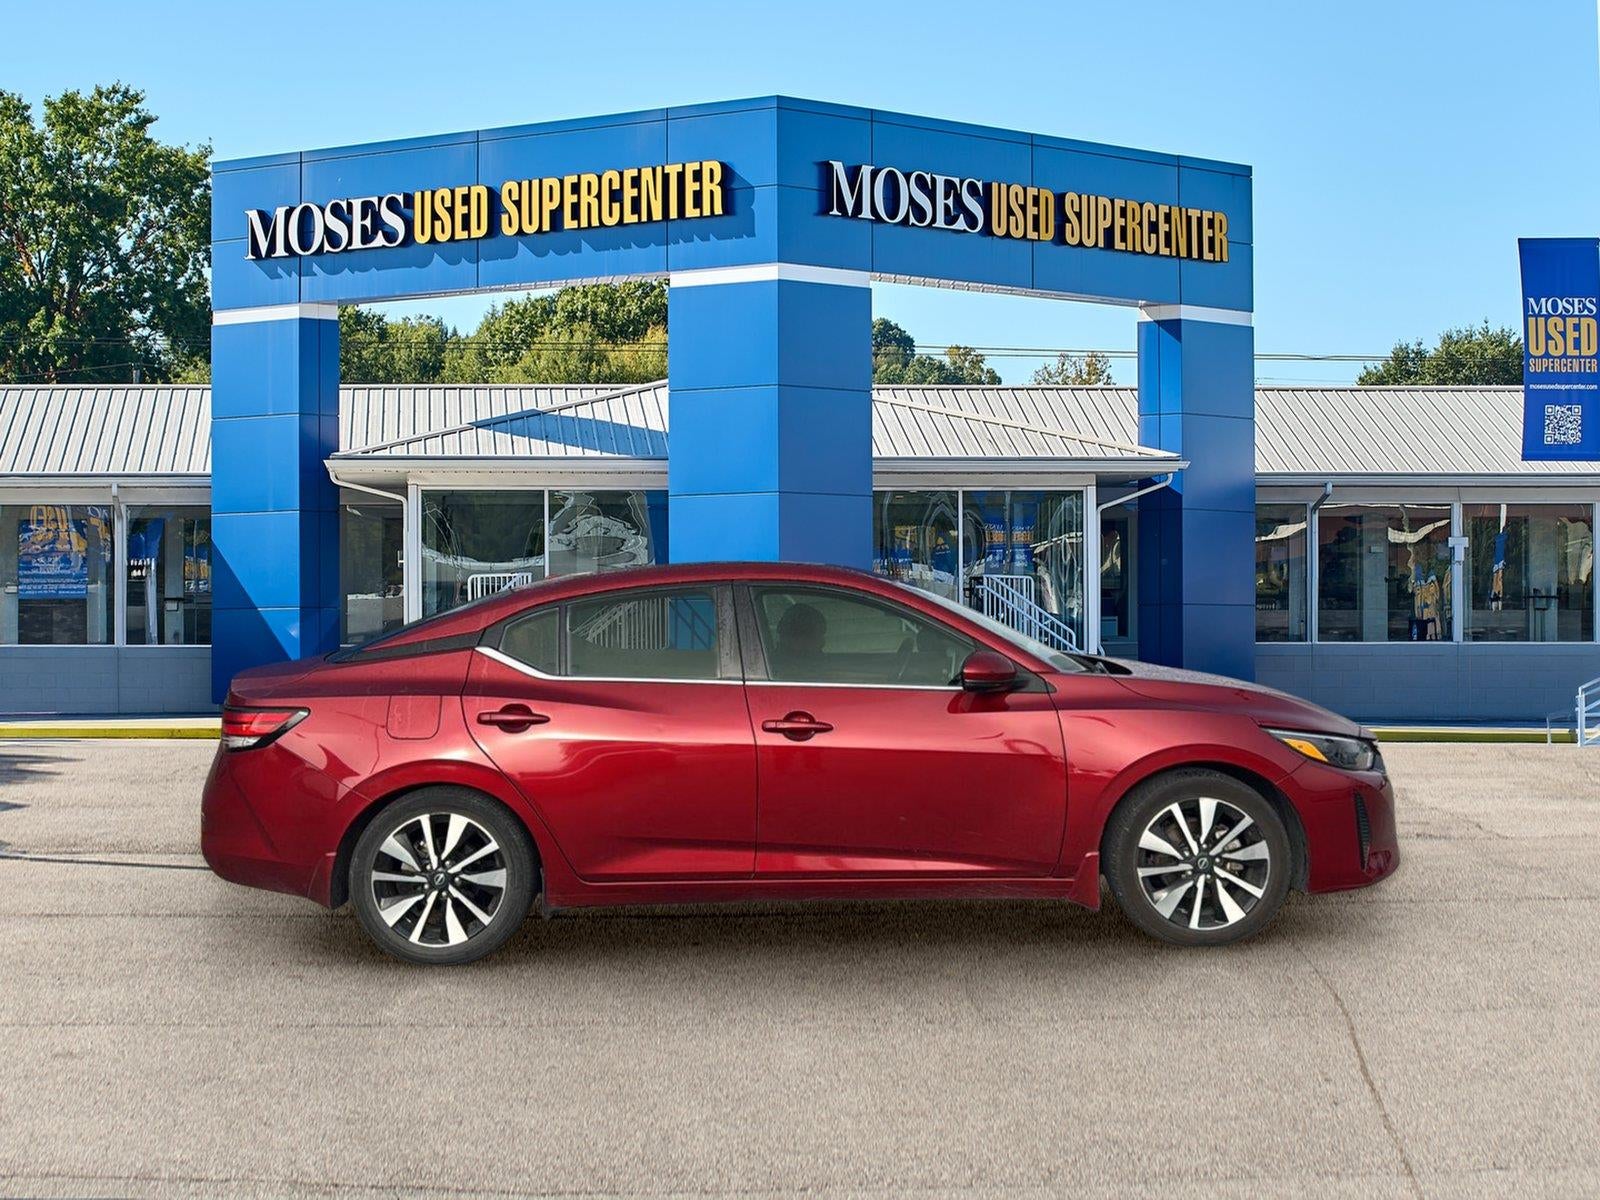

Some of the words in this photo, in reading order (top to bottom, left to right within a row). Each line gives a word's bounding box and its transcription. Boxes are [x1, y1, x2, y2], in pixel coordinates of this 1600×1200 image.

[245, 193, 407, 260] MOSES
[413, 185, 489, 244] USED
[501, 160, 725, 236] SUPERCENTER
[828, 160, 984, 233] MOSES
[991, 182, 1055, 241] USED
[1064, 192, 1229, 262] SUPERCENTER
[1527, 297, 1597, 315] MOSES
[1528, 317, 1598, 356] USED
[1529, 358, 1598, 373] SUPERCENTER
